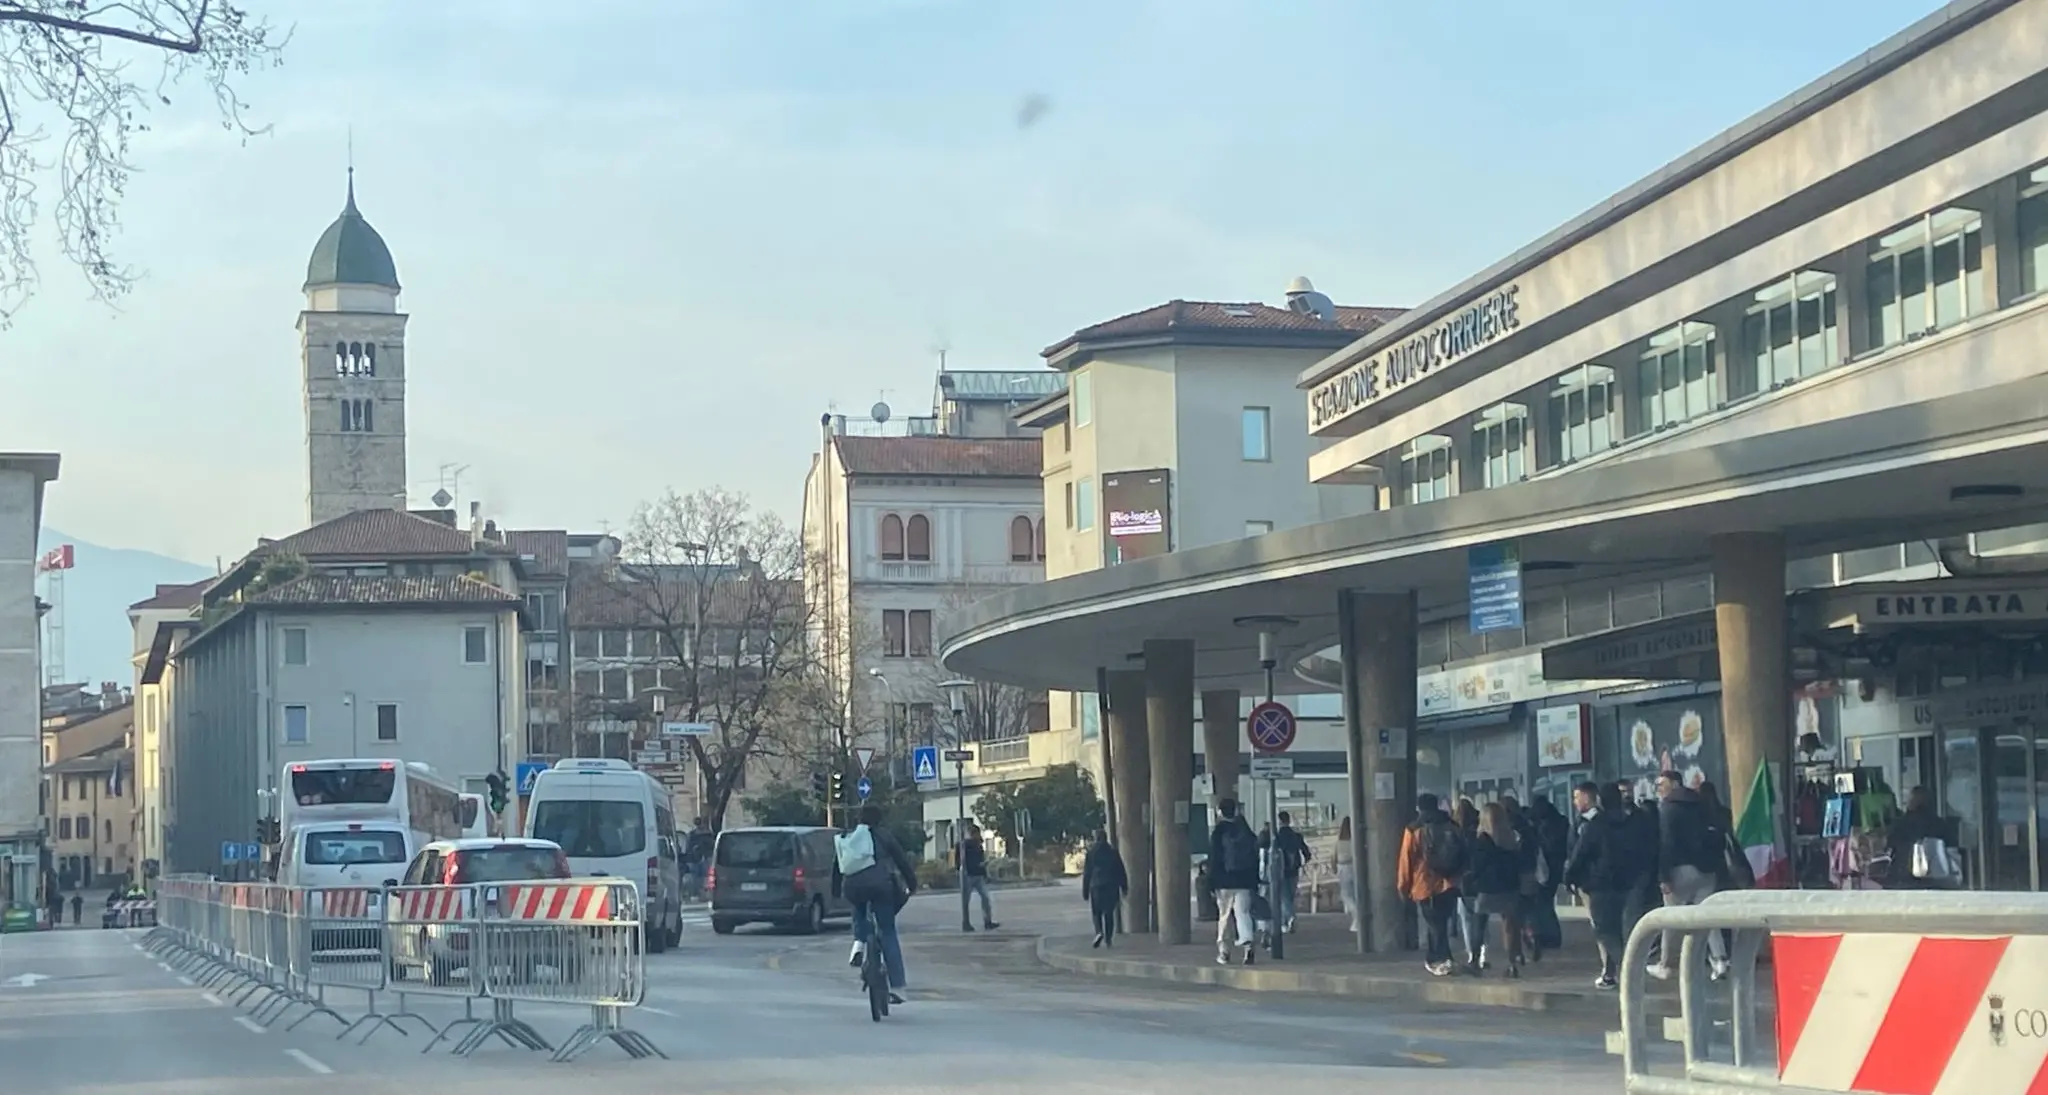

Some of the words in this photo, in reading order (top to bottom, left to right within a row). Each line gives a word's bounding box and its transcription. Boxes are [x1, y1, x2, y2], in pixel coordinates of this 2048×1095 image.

[1311, 359, 1379, 426] STAZIONE
[1384, 284, 1520, 390] AUTOCORRIERE
[1876, 594, 2024, 615] ENTRATA
